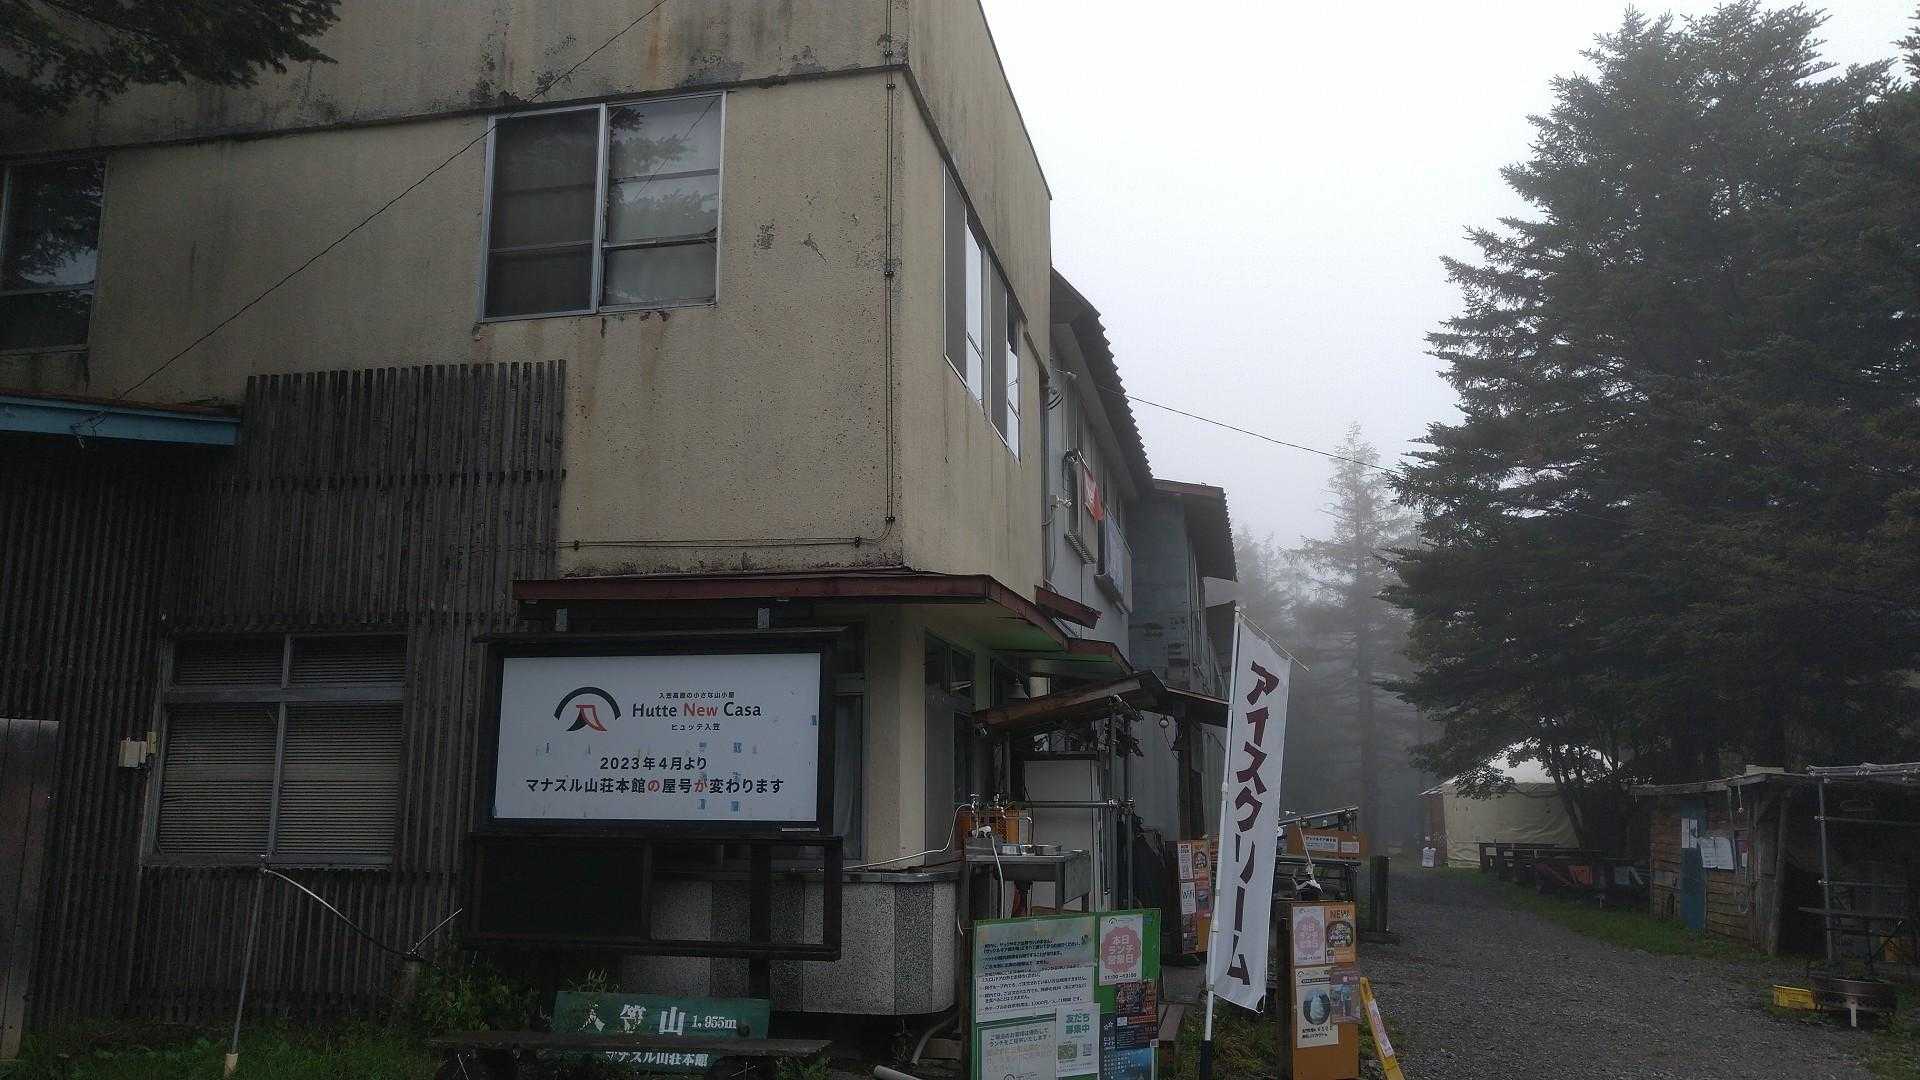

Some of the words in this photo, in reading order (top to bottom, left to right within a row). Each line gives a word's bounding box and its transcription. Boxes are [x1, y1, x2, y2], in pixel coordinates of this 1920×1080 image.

[632, 703, 677, 718] Hutte
[683, 703, 718, 718] New
[723, 702, 761, 718] Casa
[671, 722, 721, 732] ヒュッテ入笠
[600, 756, 708, 772] 2023年4月より
[526, 776, 785, 794] マナスル山荘本館の屋号が変わります
[1226, 660, 1280, 985] アイスクリーム
